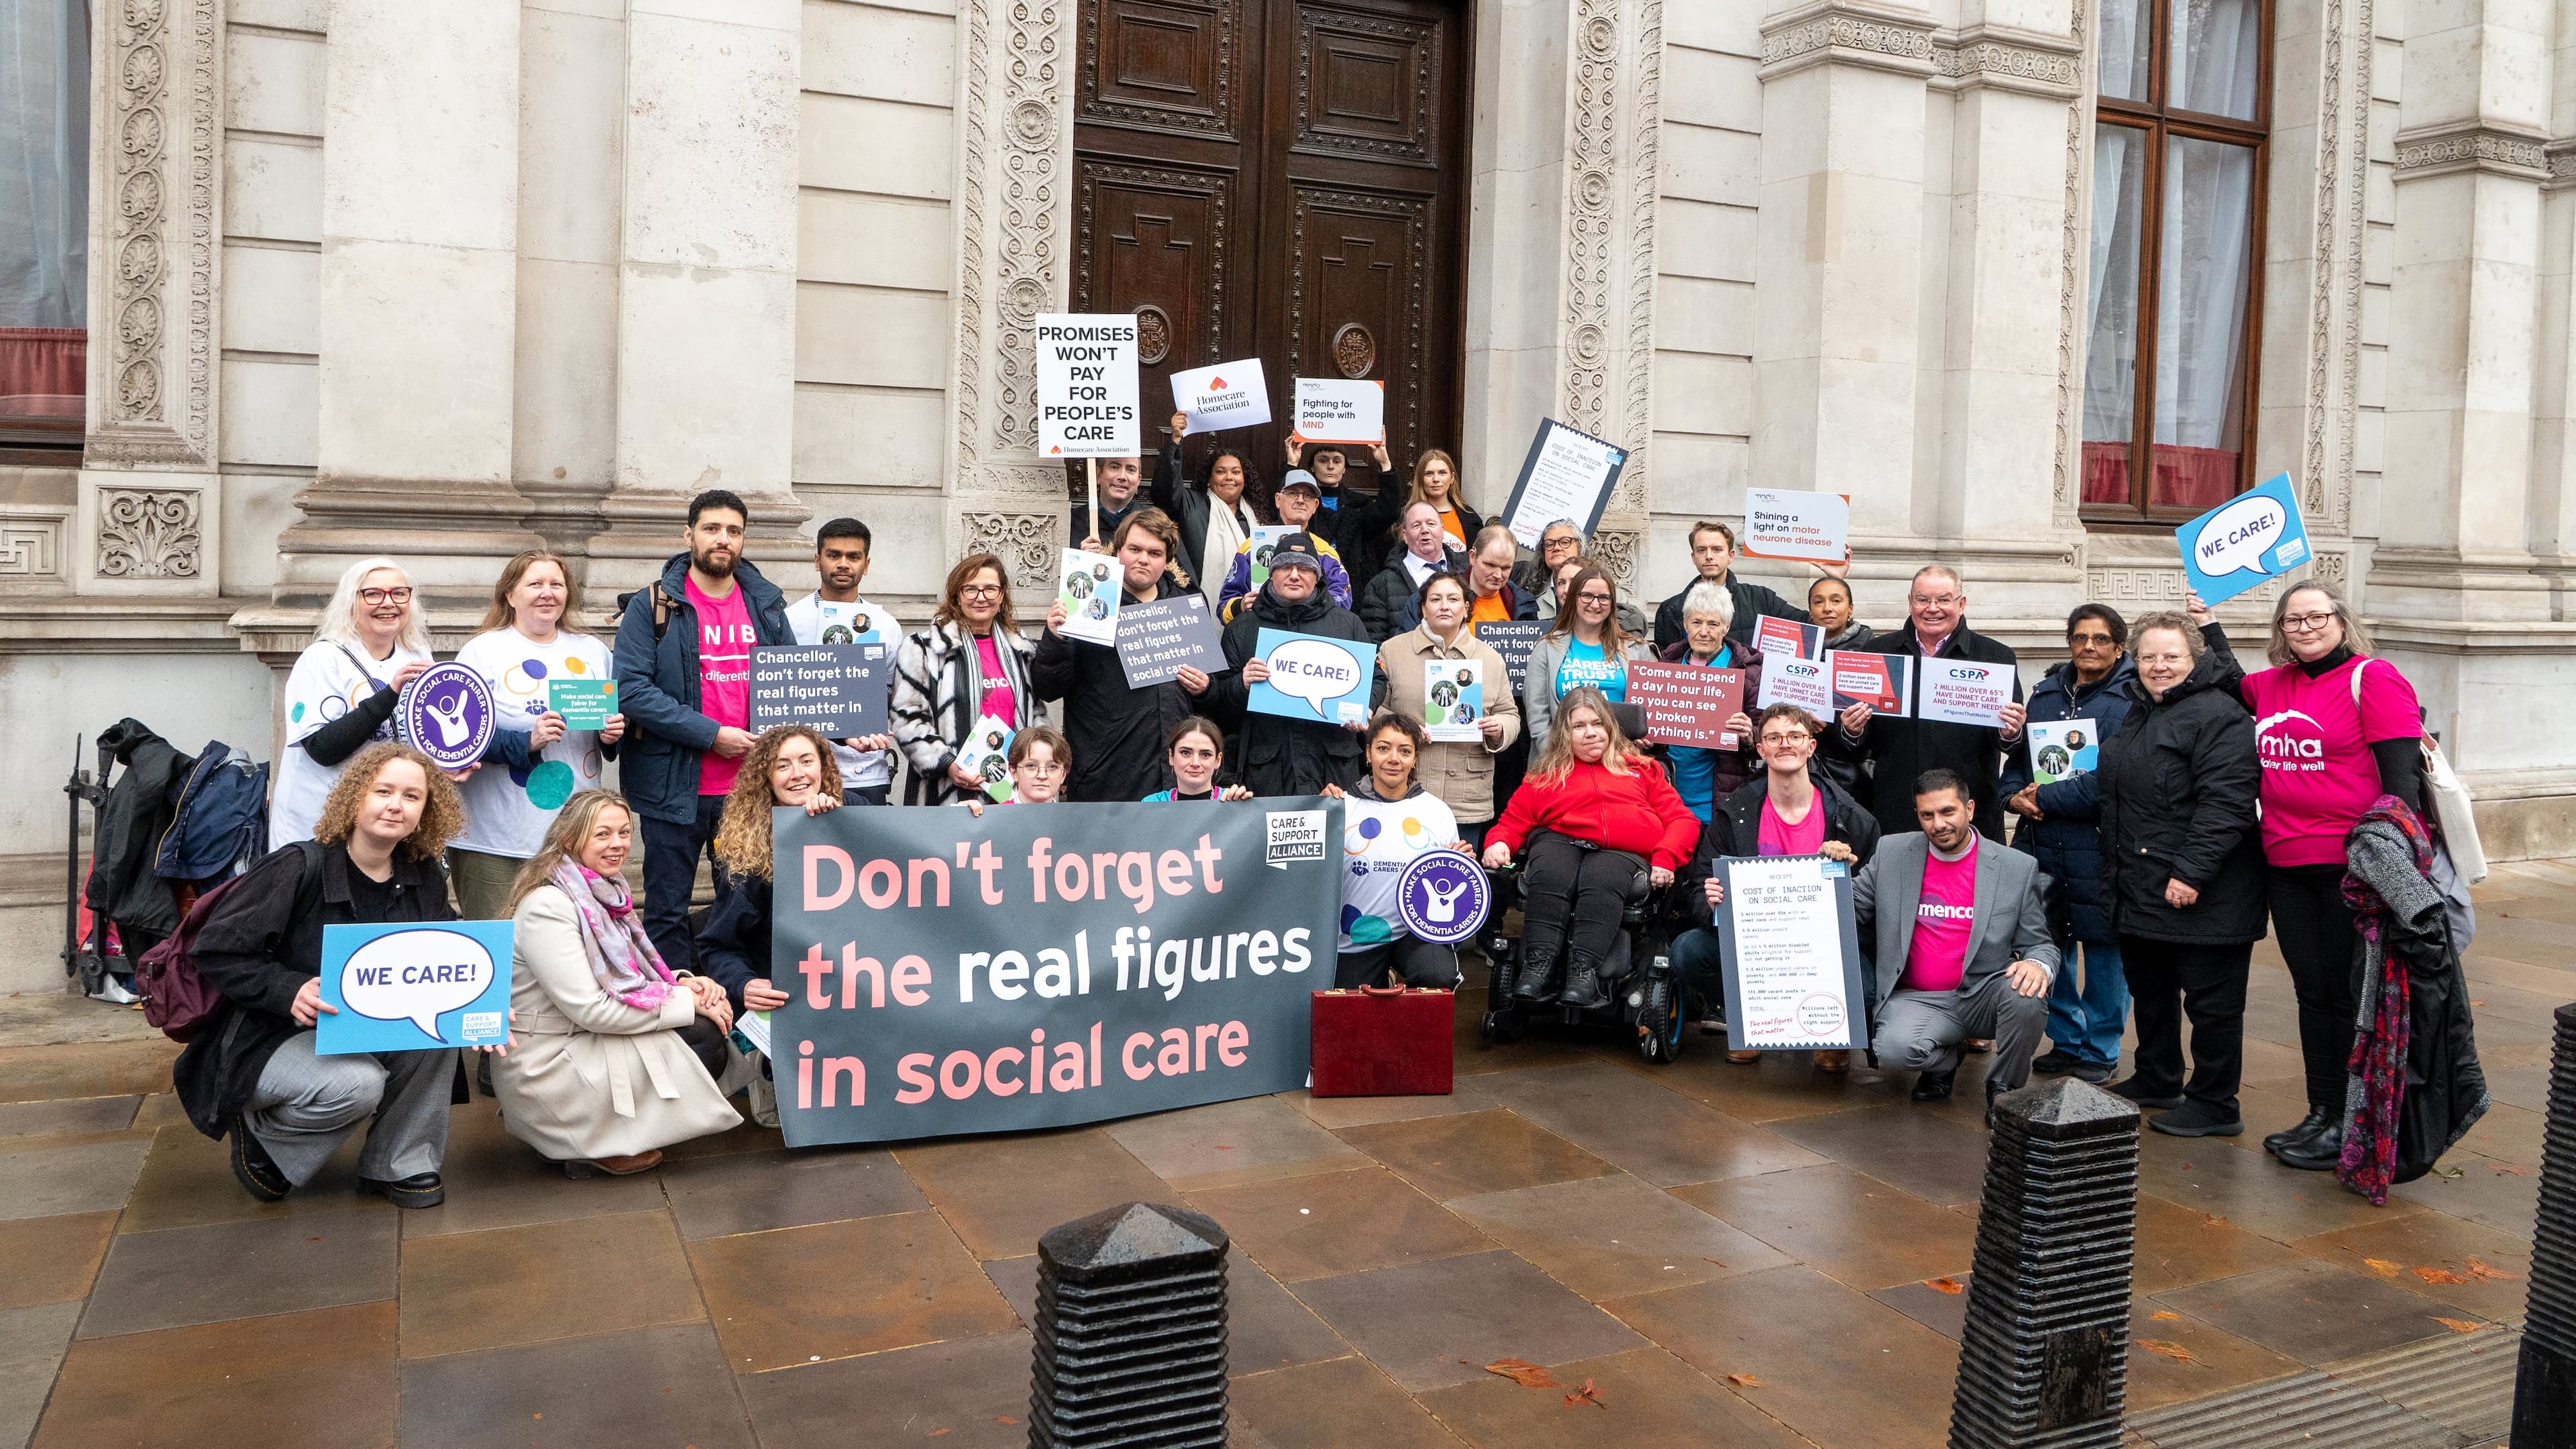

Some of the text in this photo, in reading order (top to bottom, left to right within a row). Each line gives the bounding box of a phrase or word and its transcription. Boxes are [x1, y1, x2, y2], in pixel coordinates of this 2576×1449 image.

[1039, 327, 1134, 341] PROMISES
[1055, 347, 1118, 360] WON’T
[1071, 367, 1105, 380] PAY
[1069, 386, 1107, 400] FOR
[1197, 391, 1246, 405] Homecare
[1196, 399, 1249, 415] Association
[1303, 398, 1353, 409] Fighting for
[1045, 407, 1132, 421] PEOPLE’S
[1303, 411, 1356, 419] people with
[1303, 421, 1324, 429] MND
[1064, 426, 1114, 440] CARE
[1754, 511, 1789, 523] Shining
[1754, 522, 1774, 532] light
[1792, 526, 1820, 535] motor
[2202, 513, 2275, 558] WE CARE!
[1753, 534, 1832, 547] neurone disease
[1146, 617, 1179, 633] forget
[1181, 614, 1199, 626] the
[1481, 625, 1543, 636] Chancellor,
[698, 624, 756, 645] NIB
[1122, 633, 1182, 651] real figures
[757, 649, 837, 663] Chancellor,
[1127, 643, 1203, 666] that matter in
[757, 666, 869, 682] don’t forget the
[1133, 666, 1164, 681] social
[1276, 659, 1350, 681] WE CARE!
[1562, 669, 1617, 680] TRUST
[1674, 670, 1697, 680] and
[1700, 674, 1735, 684] spend
[1786, 665, 1815, 677] CSPA
[1949, 667, 1987, 680] CSPA
[442, 672, 465, 683] CARE
[1777, 678, 1800, 687] MILLION
[1801, 682, 1817, 690] OVER
[419, 676, 443, 704] SOCIAL
[465, 678, 486, 709] FAIRER
[757, 686, 839, 700] real figures
[1642, 681, 1664, 694] day
[1666, 683, 1678, 693] in
[1680, 686, 1701, 695] our
[1703, 686, 1725, 699] life,
[1790, 688, 1809, 696] UNMET
[1810, 691, 1825, 699] CARE
[1940, 684, 1967, 693] MILLION
[1631, 696, 1717, 711] so you can see
[1784, 692, 1809, 702] SUPPORT
[1936, 691, 1953, 699] HAVE
[1955, 694, 1979, 702] UNMET
[757, 700, 862, 716] that matter in
[1949, 700, 1980, 709] SUPPORT
[1982, 703, 2003, 711] NEEDS
[1656, 711, 1695, 724] broken
[1943, 708, 1991, 719] #FiguresThatMatter
[415, 706, 425, 737] MAKE
[423, 714, 488, 760] FOR DEMENTIA CARERS
[1648, 726, 1691, 741] rything
[2261, 733, 2322, 758] mha
[2283, 761, 2324, 771] life well
[1271, 816, 1305, 828] CARE &
[1272, 830, 1318, 842] SUPPORT
[1270, 844, 1321, 858] ALLIANCE
[1028, 833, 1223, 914] forget
[1405, 859, 1482, 905] MAKE SOCIAL CARE FAIRER
[1743, 888, 1762, 896] COST
[1782, 885, 1822, 894] INACTION
[1764, 896, 1793, 904] SOCIAL
[1797, 895, 1817, 903] CARE
[1406, 903, 1479, 935] FOR DEMENTIA CARERS
[356, 964, 476, 986] WE CARE!
[798, 926, 1312, 1010] the real figures
[1762, 1018, 1772, 1026] real
[1774, 1016, 1794, 1026] figures
[464, 1028, 500, 1036] ALLIANCE
[1766, 1027, 1786, 1035] matter
[798, 1020, 1250, 1110] in social care
